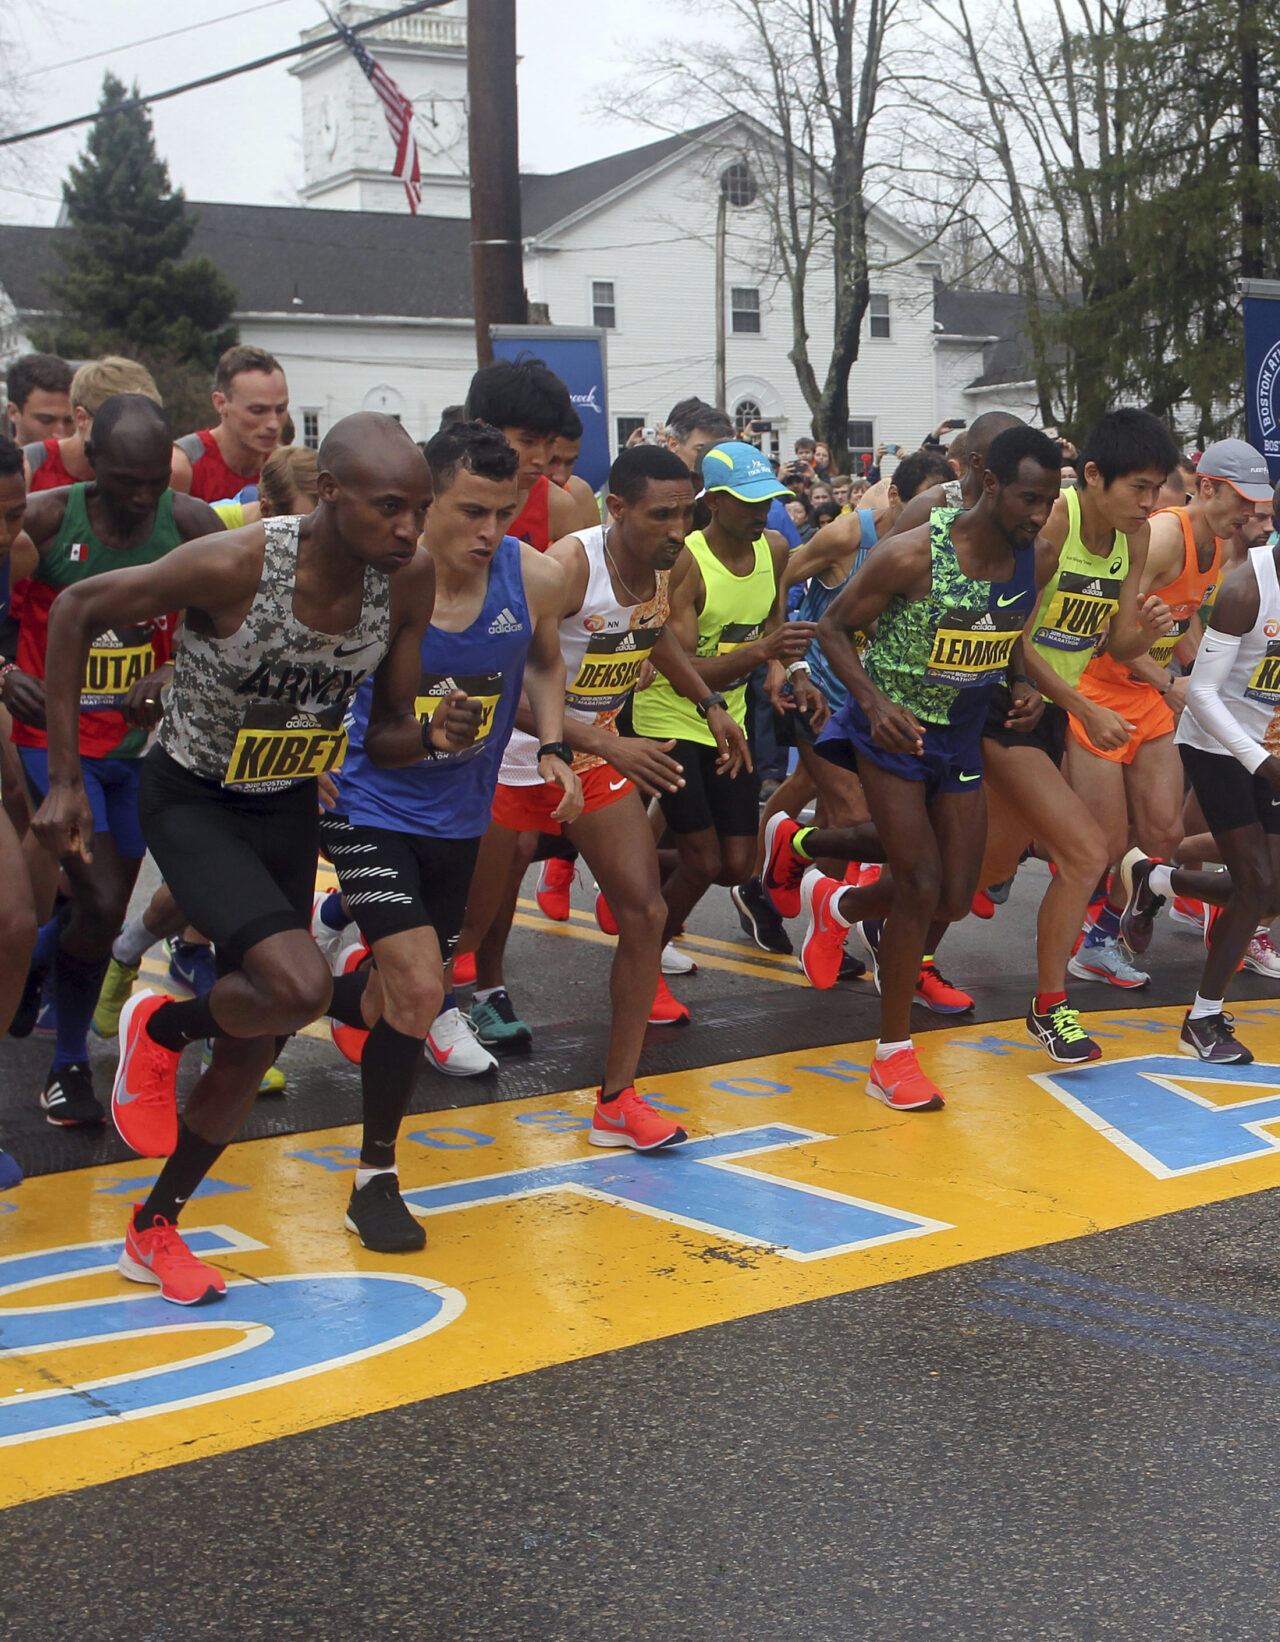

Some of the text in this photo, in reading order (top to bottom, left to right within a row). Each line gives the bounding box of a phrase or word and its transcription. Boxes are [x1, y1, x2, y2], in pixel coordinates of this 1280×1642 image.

[570, 385, 602, 414] cock
[1259, 371, 1273, 428] BOSTON
[488, 622, 524, 635] adidas
[607, 621, 620, 629] NN
[1055, 596, 1112, 635] YUKI
[933, 637, 1014, 667] LEMMA
[85, 651, 152, 690] UTAI
[235, 663, 367, 704] ARMY
[575, 659, 643, 689] DEKSIS
[234, 732, 348, 781] KIBET
[261, 779, 293, 788] BOSTON
